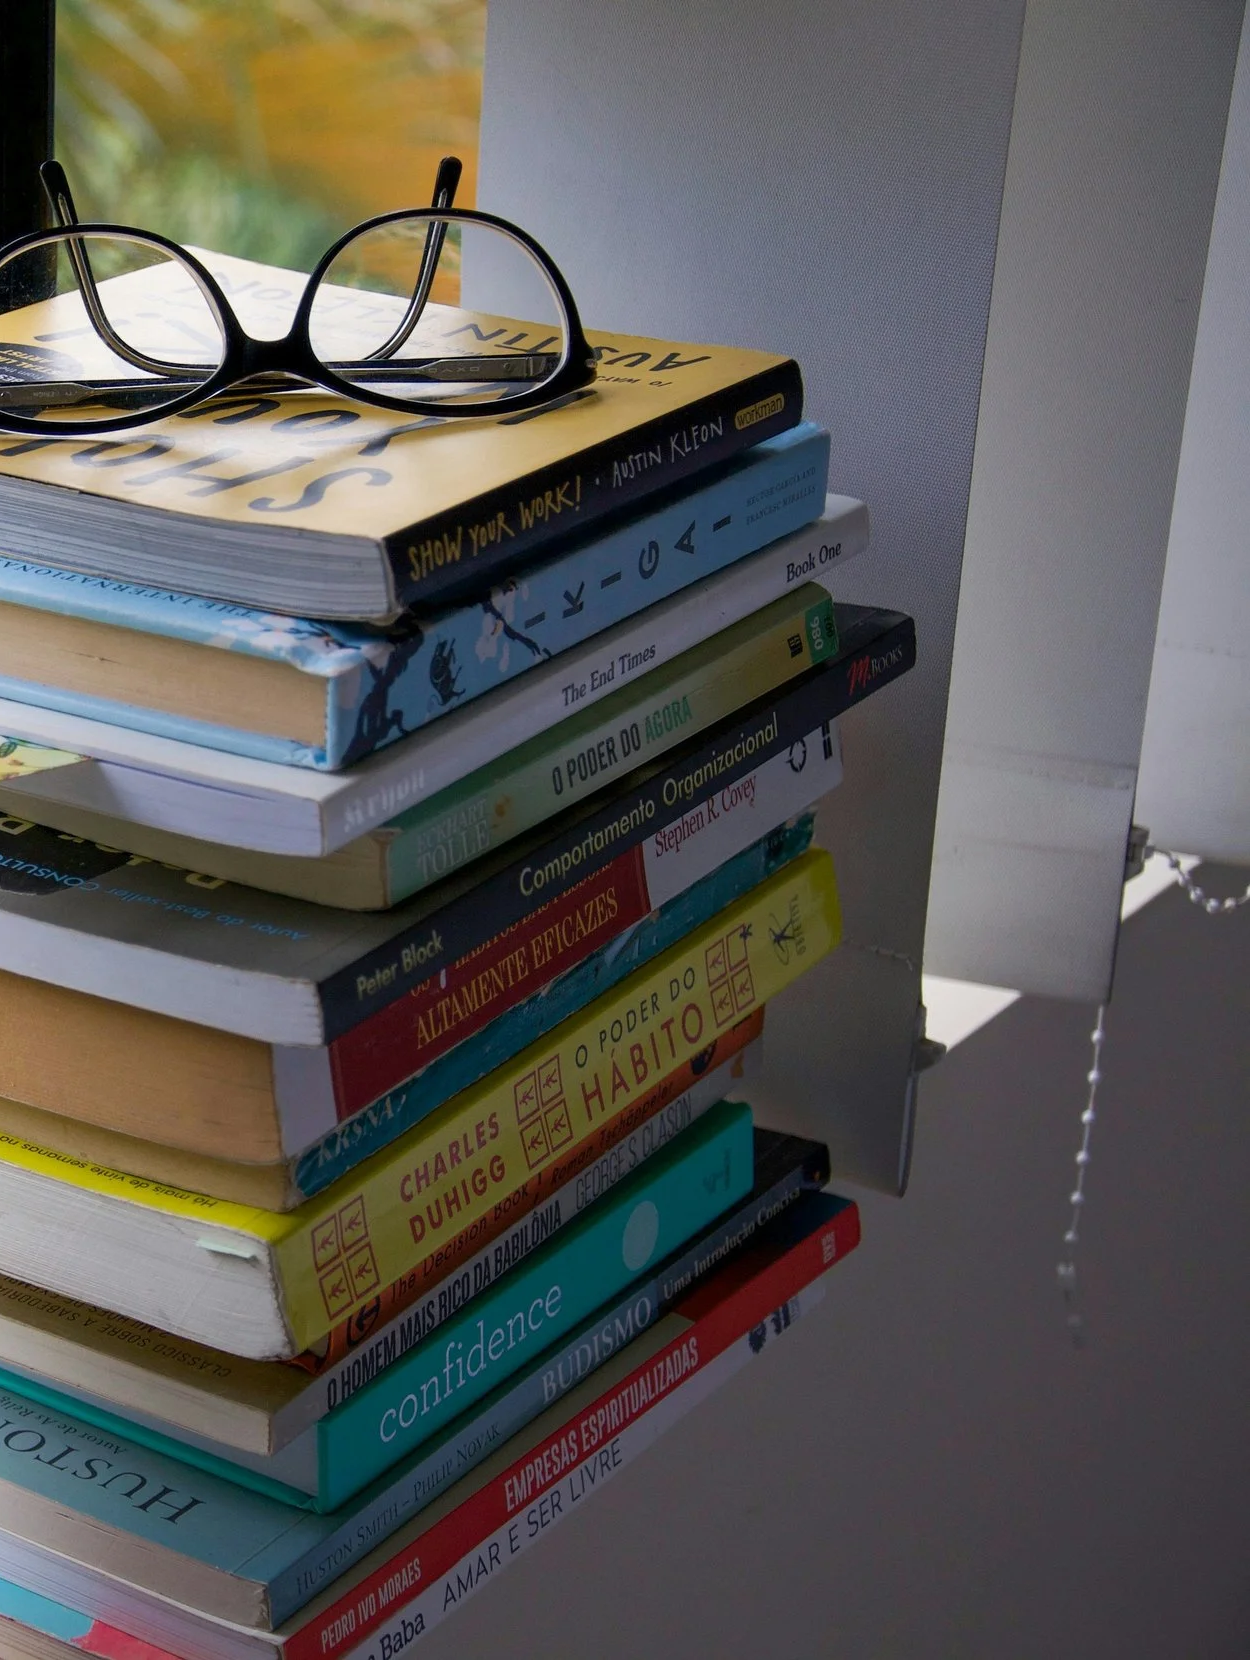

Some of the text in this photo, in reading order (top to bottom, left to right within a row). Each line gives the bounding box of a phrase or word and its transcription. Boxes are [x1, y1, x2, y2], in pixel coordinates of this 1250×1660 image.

[735, 395, 785, 430] workman
[407, 415, 724, 583] SHOW YOUR WORK! AUSTIN KLEON
[785, 540, 843, 584] Book One
[561, 642, 657, 707] The End Times
[551, 696, 694, 797] O PODER DO AGORA
[356, 962, 398, 1001] Peter
[401, 930, 443, 974] Block
[519, 799, 656, 898] Comportamento
[662, 710, 779, 806] Organizacional
[416, 820, 491, 881] TOLLE
[653, 800, 706, 859] Stephen
[720, 774, 758, 819] Covey
[214, 913, 246, 928] do
[249, 922, 308, 942] Autor
[416, 945, 530, 1051] ALTAMENTE
[531, 886, 619, 970] EFICAZES
[573, 966, 696, 1070] O PODER DO
[579, 1002, 704, 1121] HÁBITO
[20, 1142, 89, 1171] semanas
[90, 1166, 127, 1183] vinte
[129, 1178, 151, 1190] de
[152, 1184, 191, 1202] mais
[399, 1111, 501, 1202] CHARLES
[408, 1154, 506, 1245] DUHIGG
[326, 1377, 338, 1410] O
[340, 1328, 397, 1400] HOMEM
[399, 1300, 437, 1358] MAIS
[438, 1271, 471, 1322] RICO
[472, 1258, 492, 1292] DA
[493, 1199, 563, 1277] BABILÔNIA
[574, 1144, 626, 1210] GEORGE
[641, 1091, 692, 1158] CLASON
[390, 1271, 416, 1303] The
[422, 1219, 487, 1280] Decision
[493, 1184, 530, 1222] Book
[97, 1322, 152, 1349] SOBRE
[540, 1295, 653, 1405] BUDISMO
[662, 1270, 692, 1300] Uma
[692, 1222, 756, 1278] Introdução
[378, 1283, 562, 1444] confidence
[35, 1413, 58, 1430] As
[79, 1430, 128, 1457] Autor
[295, 1421, 501, 1595] HUSTON SMITH PHILIP NOVAK
[320, 1337, 700, 1654] PEDRO IVO MORAES EMPRESAS ESPIRITUALIZADAS
[378, 1437, 624, 1660] Baba AMAR E SER LIVRE
